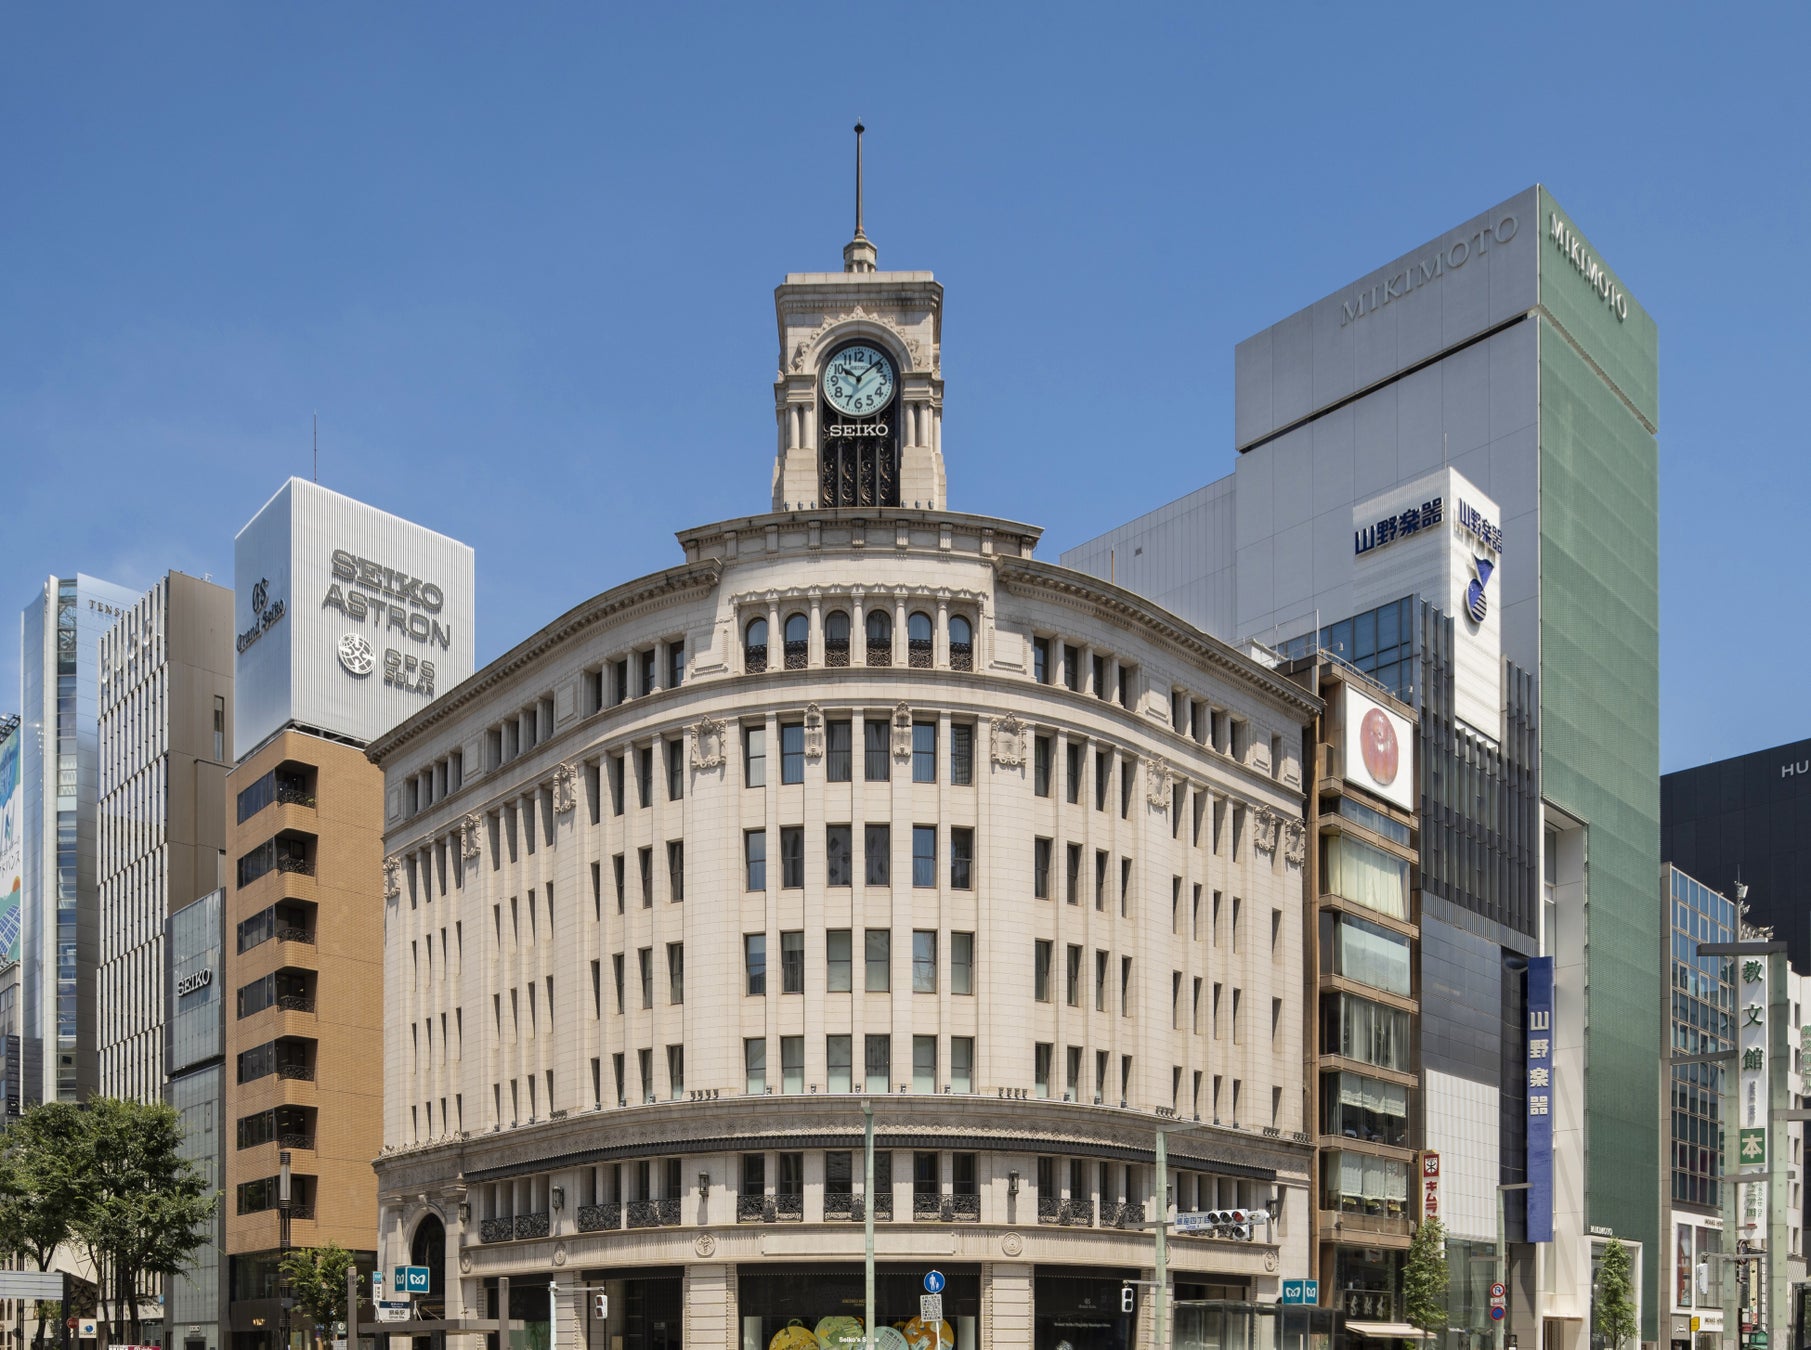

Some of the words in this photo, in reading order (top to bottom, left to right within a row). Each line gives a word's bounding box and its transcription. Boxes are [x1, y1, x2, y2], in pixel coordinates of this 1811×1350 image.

[1340, 216, 1519, 328] MIKIMOTO
[1550, 212, 1627, 322] MIKIMOTO
[834, 363, 844, 374] 10
[844, 354, 852, 365] 11
[854, 351, 865, 362] 12
[868, 354, 872, 365] 1
[830, 375, 839, 386] 9
[834, 386, 843, 398] 8
[875, 386, 884, 398] 4
[879, 374, 887, 386] 3
[844, 395, 853, 406] 7
[854, 398, 863, 409] 6
[866, 395, 874, 406] 5
[830, 424, 888, 437] SEIKO
[1355, 497, 1443, 555] 山野楽器
[1459, 498, 1502, 554] 山野楽器
[332, 549, 444, 610] SEIKO
[237, 617, 262, 654] Grand
[262, 599, 286, 631] Seiko
[322, 583, 450, 648] ASTRON
[384, 648, 435, 680] GPS
[384, 669, 435, 694] SOLAR
[177, 968, 211, 997] SEIKO
[1742, 960, 1763, 1071] 教文館
[1530, 1011, 1549, 1116] 山野楽器
[1742, 1134, 1763, 1159] 本
